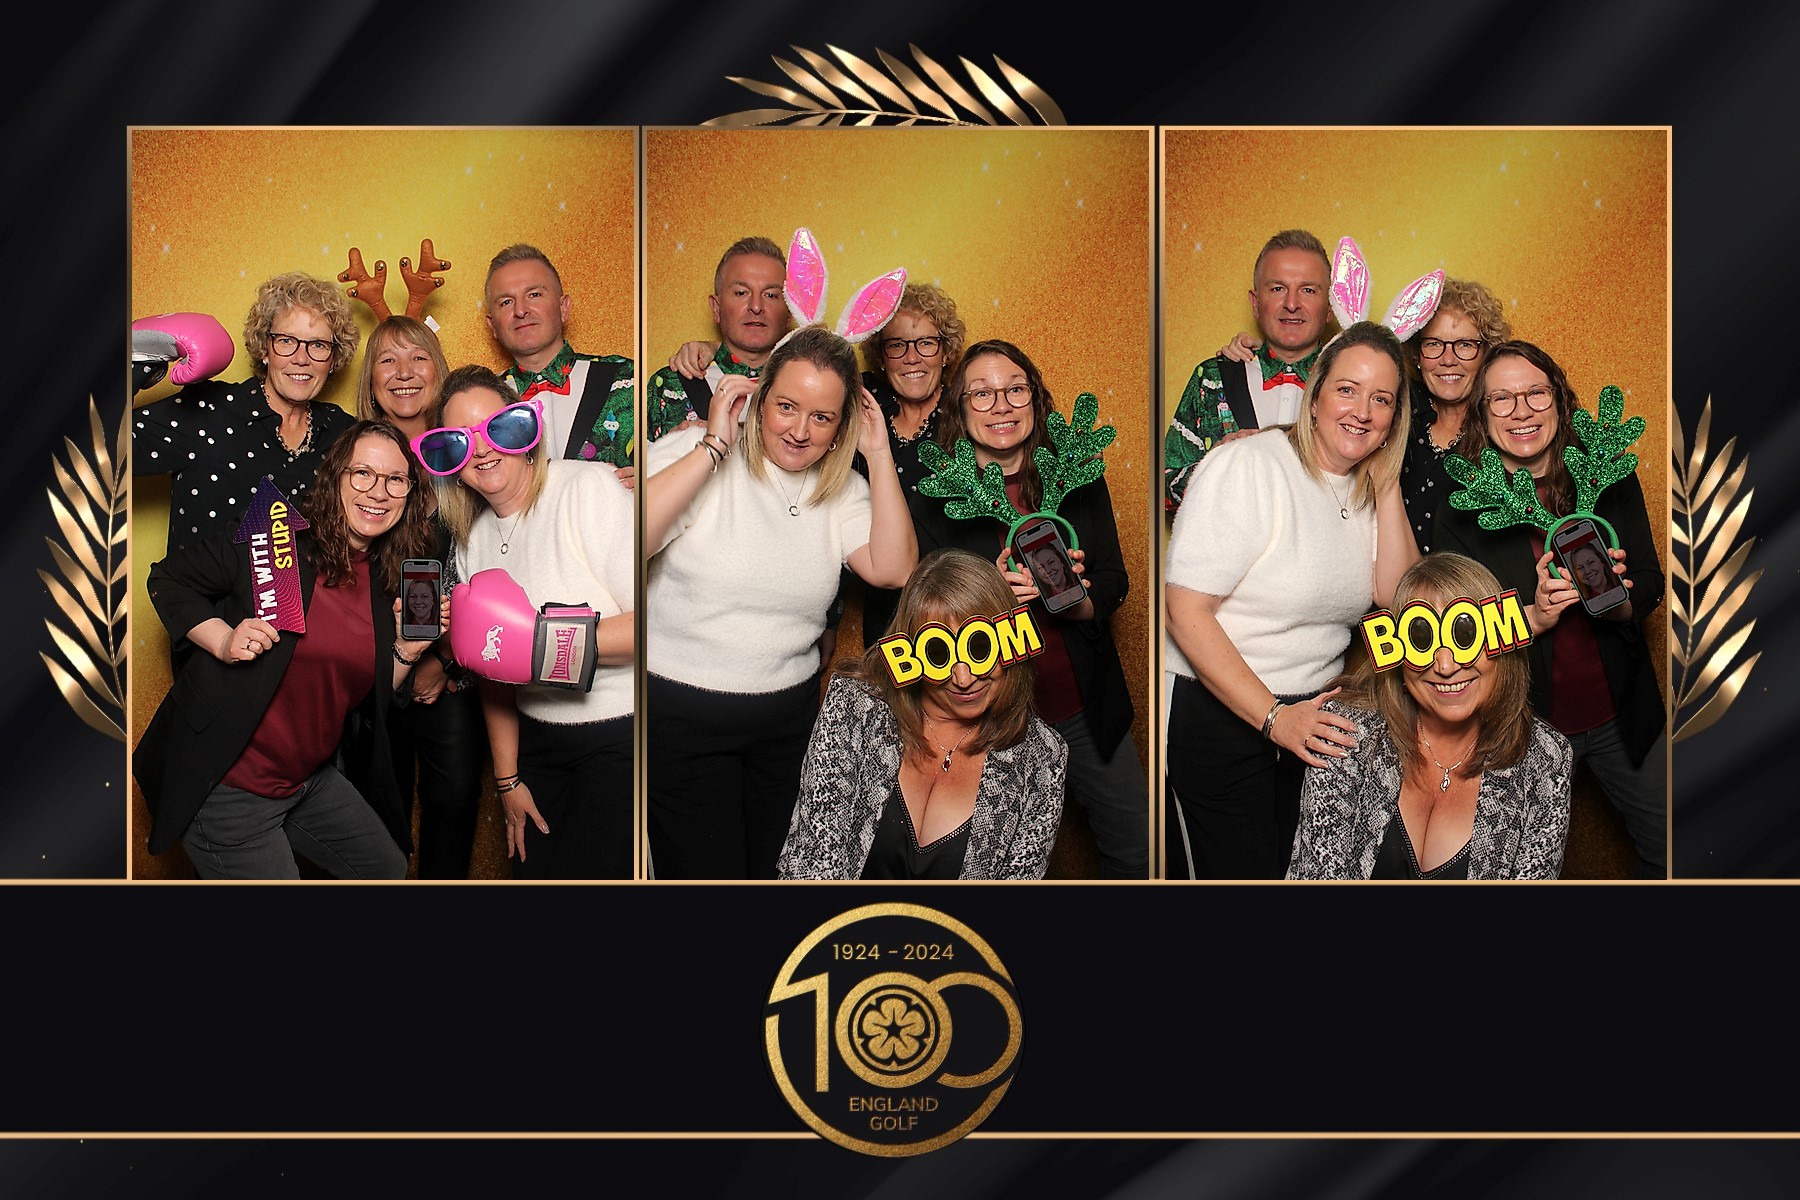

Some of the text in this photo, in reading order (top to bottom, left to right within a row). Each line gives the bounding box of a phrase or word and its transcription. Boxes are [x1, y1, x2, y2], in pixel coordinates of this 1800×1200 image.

[270, 500, 293, 570] STUPID
[251, 532, 278, 622] I'M WITH
[548, 627, 577, 680] LONSDALE
[879, 608, 1043, 686] BOOM
[1362, 592, 1531, 670] BOOM
